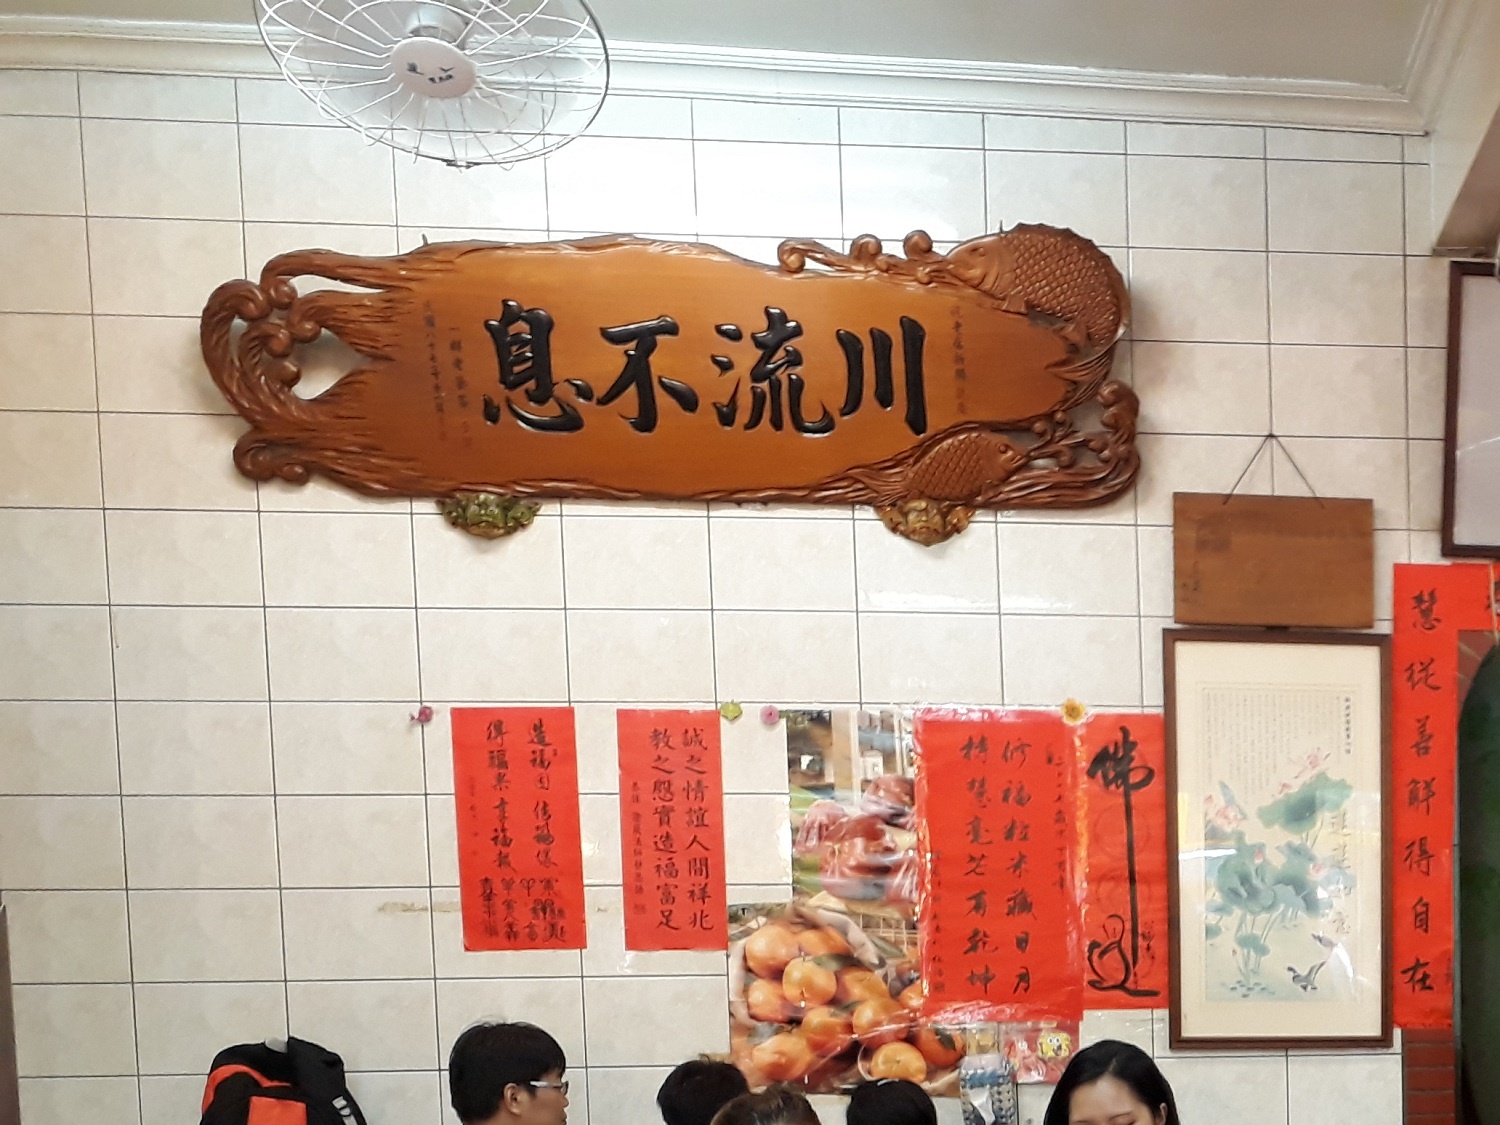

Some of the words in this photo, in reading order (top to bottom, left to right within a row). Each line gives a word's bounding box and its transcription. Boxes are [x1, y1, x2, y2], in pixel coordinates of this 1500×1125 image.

[483, 299, 927, 437] 川流不息
[1401, 588, 1442, 991] 慧從善解得自在
